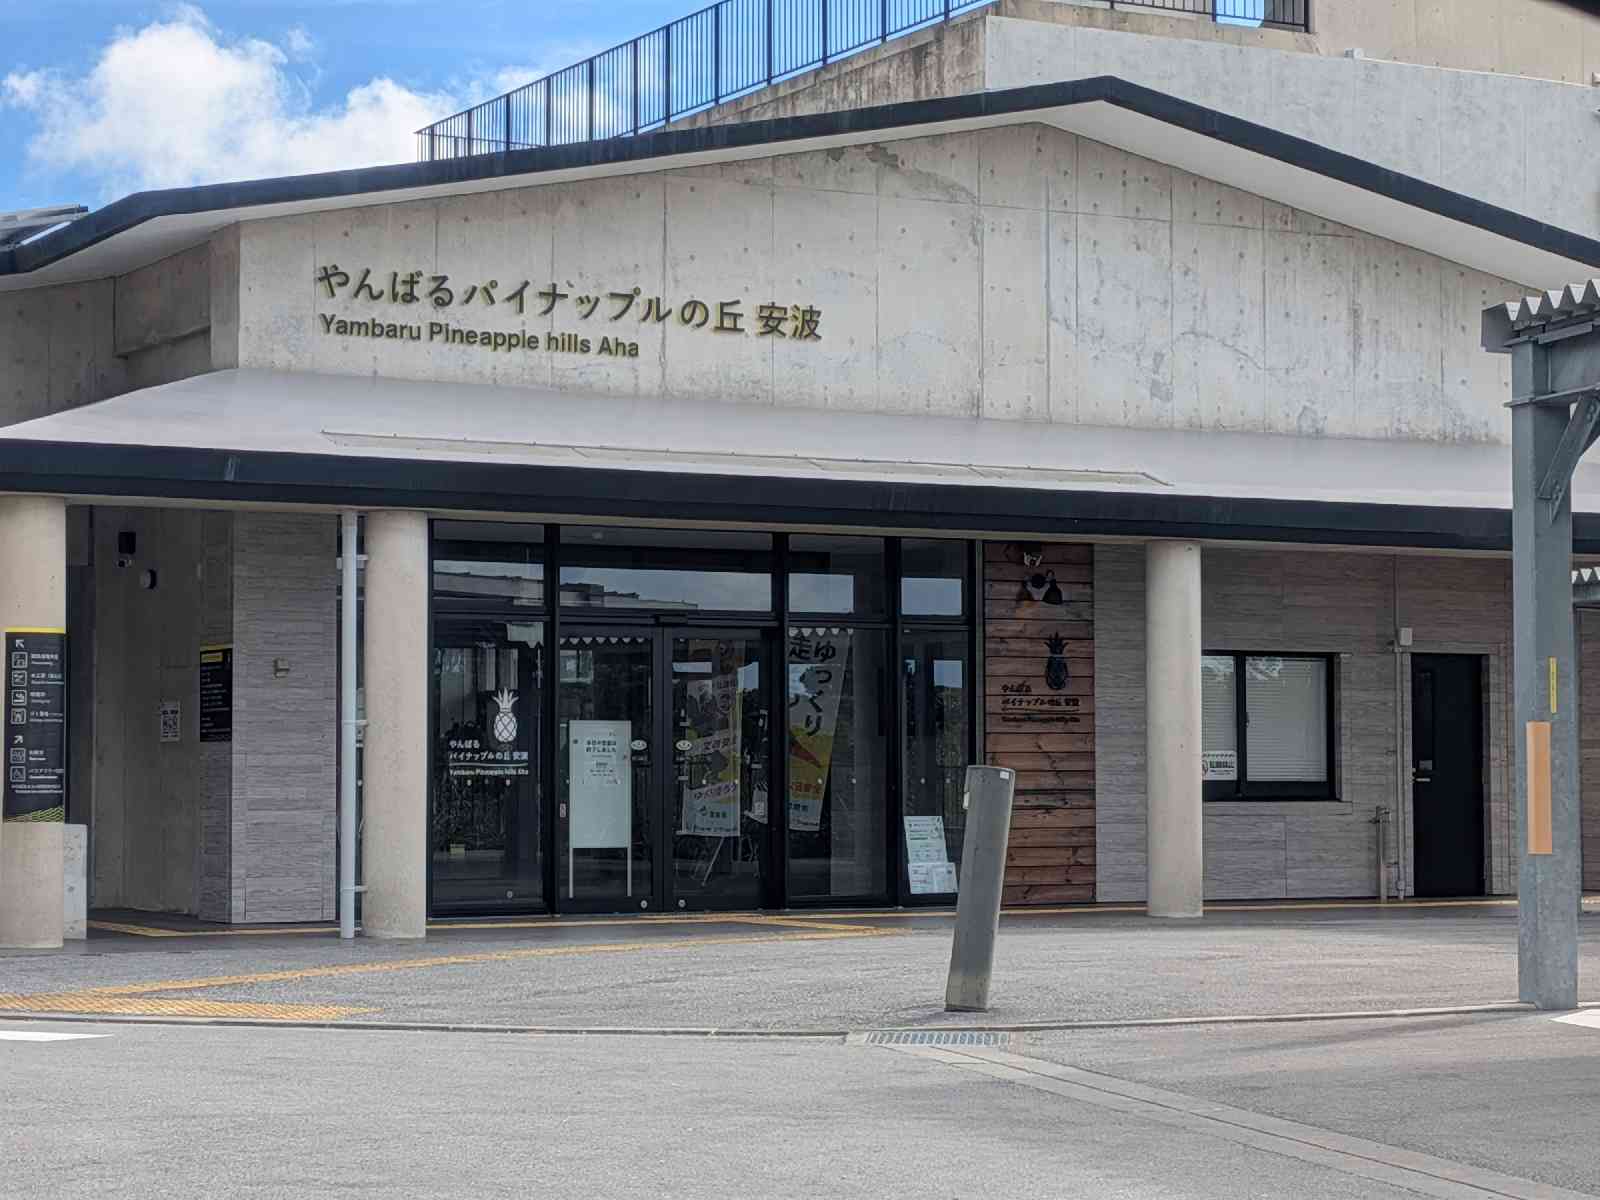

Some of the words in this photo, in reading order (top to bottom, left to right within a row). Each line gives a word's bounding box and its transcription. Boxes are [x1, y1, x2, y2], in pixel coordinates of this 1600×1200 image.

[319, 312, 422, 341] Yambaru
[428, 322, 540, 353] Pineapple
[547, 331, 592, 354] hills
[597, 335, 640, 357] Aha
[758, 301, 823, 341] 安波
